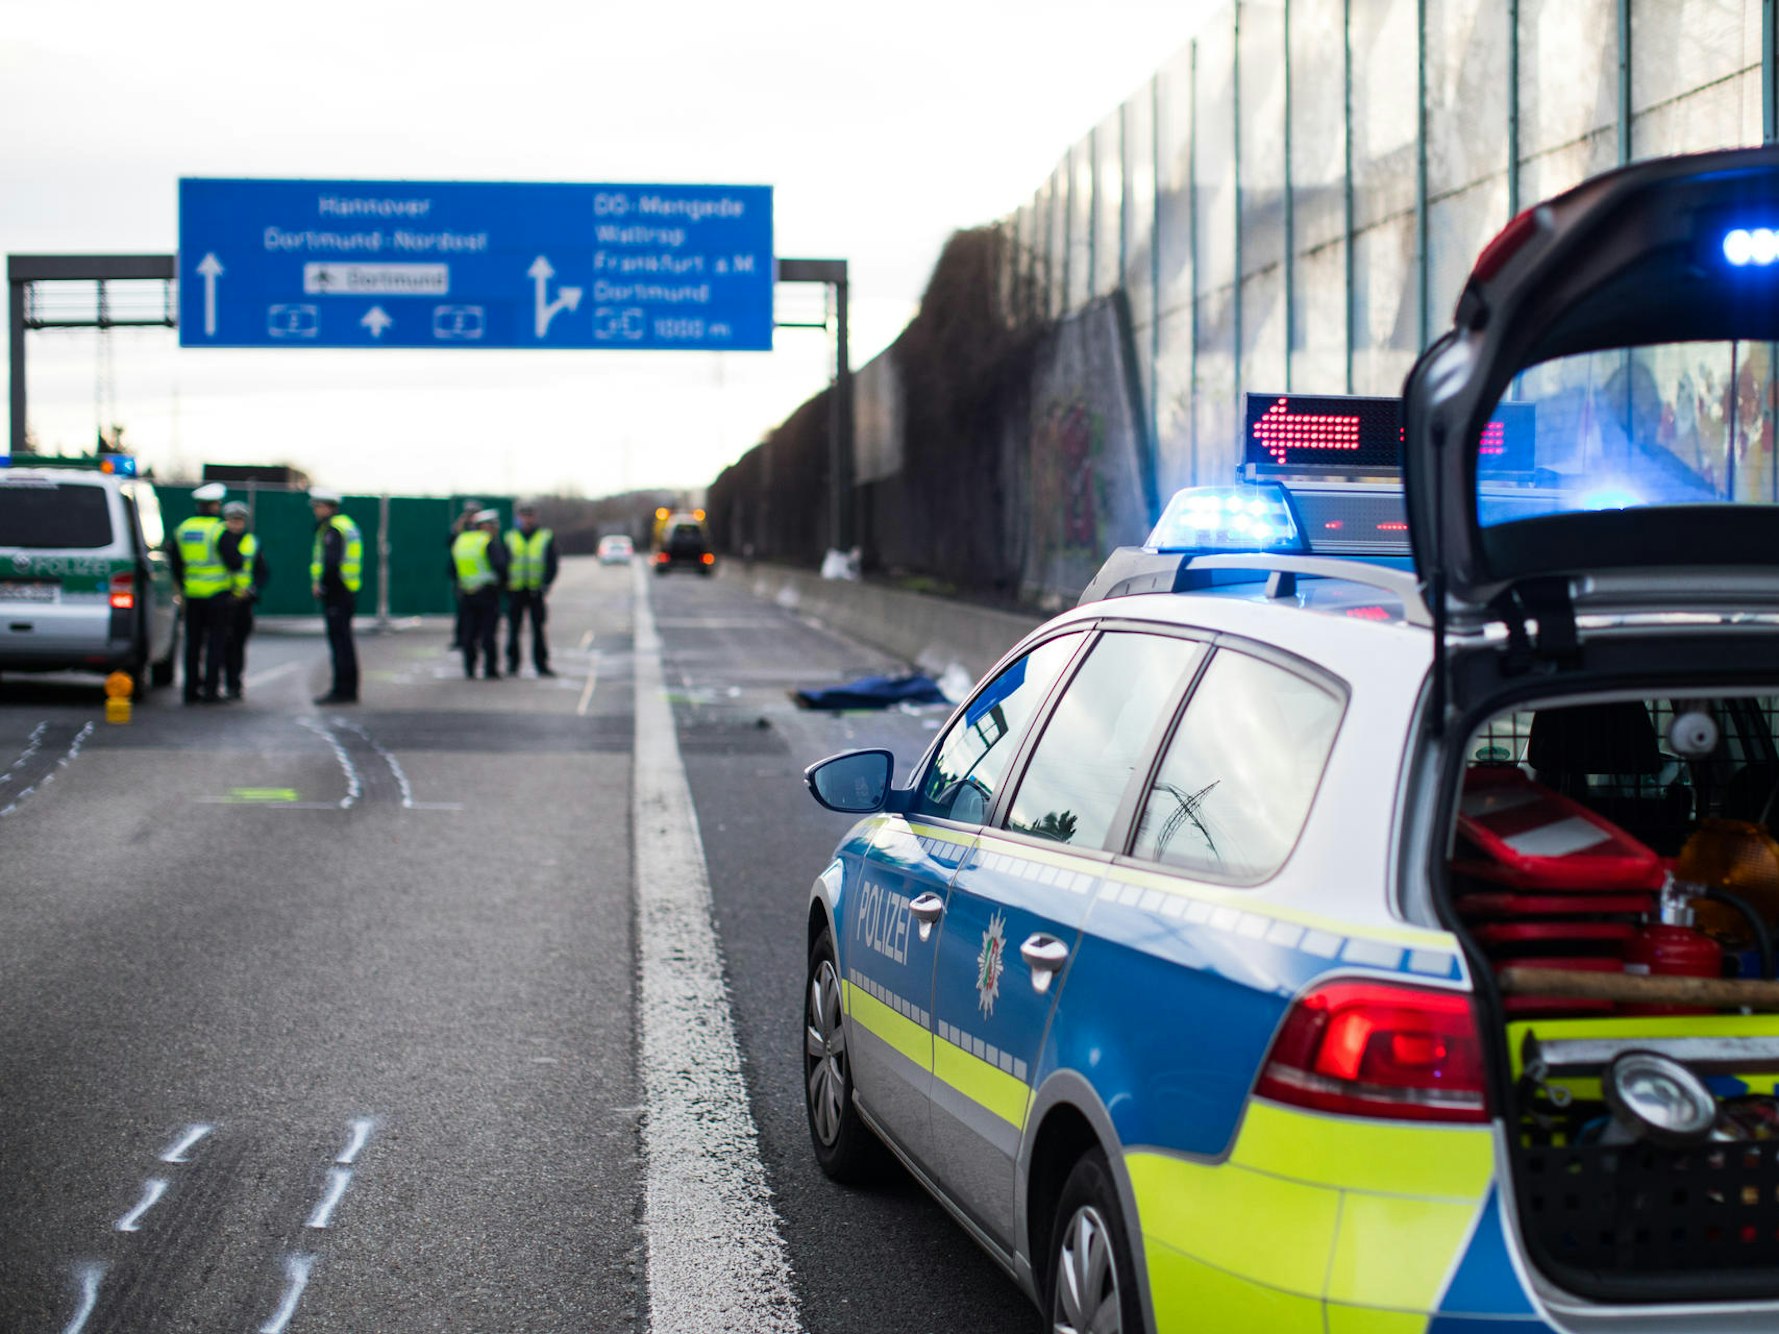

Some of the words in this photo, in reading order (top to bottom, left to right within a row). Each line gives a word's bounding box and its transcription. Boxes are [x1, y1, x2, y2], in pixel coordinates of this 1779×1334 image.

[318, 196, 431, 216] Hannover
[593, 250, 704, 273] Frankfurt
[347, 267, 444, 289] Dortmund
[593, 279, 710, 303] Dortmund
[857, 880, 912, 966] POLIZEI
